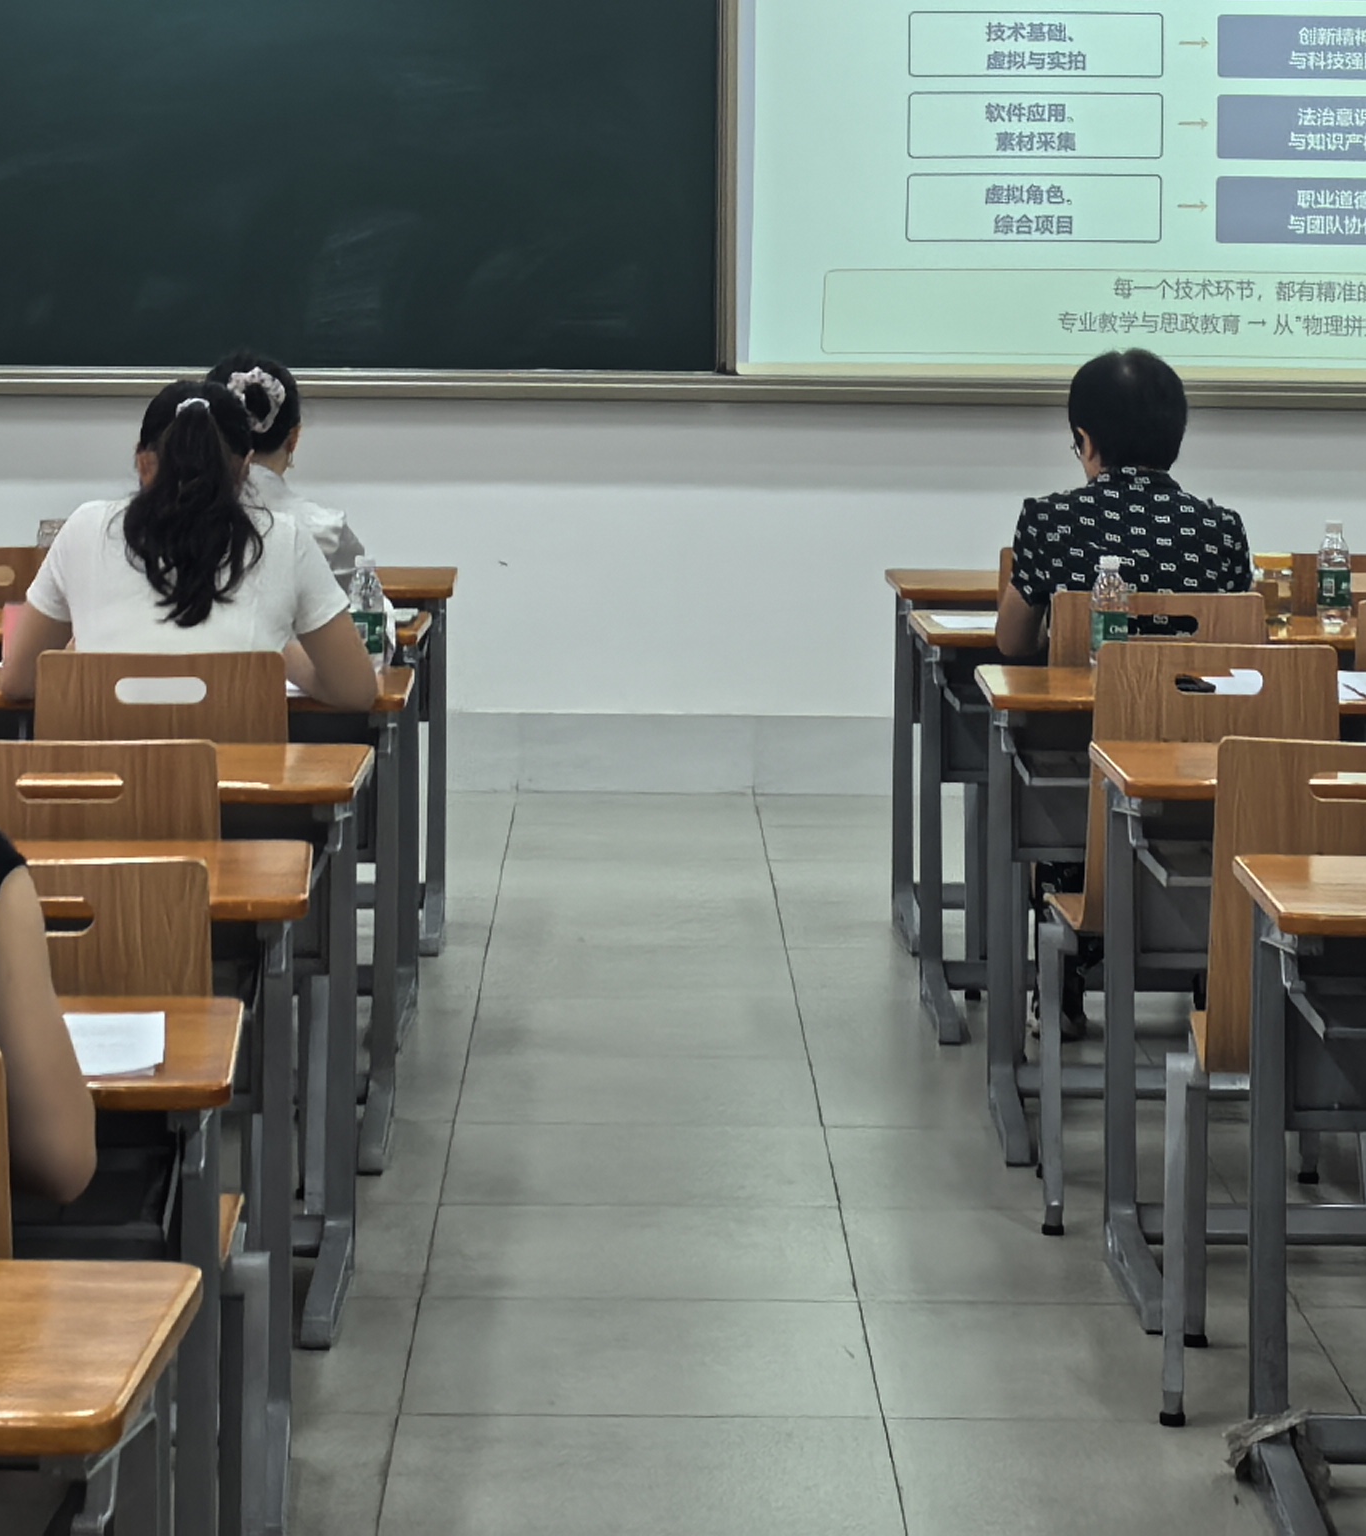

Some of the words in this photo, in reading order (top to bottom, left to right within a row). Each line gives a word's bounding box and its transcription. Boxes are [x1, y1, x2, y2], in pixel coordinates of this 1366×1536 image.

[985, 22, 1075, 43] 技术基础、
[985, 50, 1087, 72] 虚拟与实拍
[984, 102, 1075, 124] 软件应用、
[995, 131, 1077, 153] 素材采集
[993, 213, 1074, 235] 综合项目
[1058, 312, 1241, 336] 专业教学与思政教育
